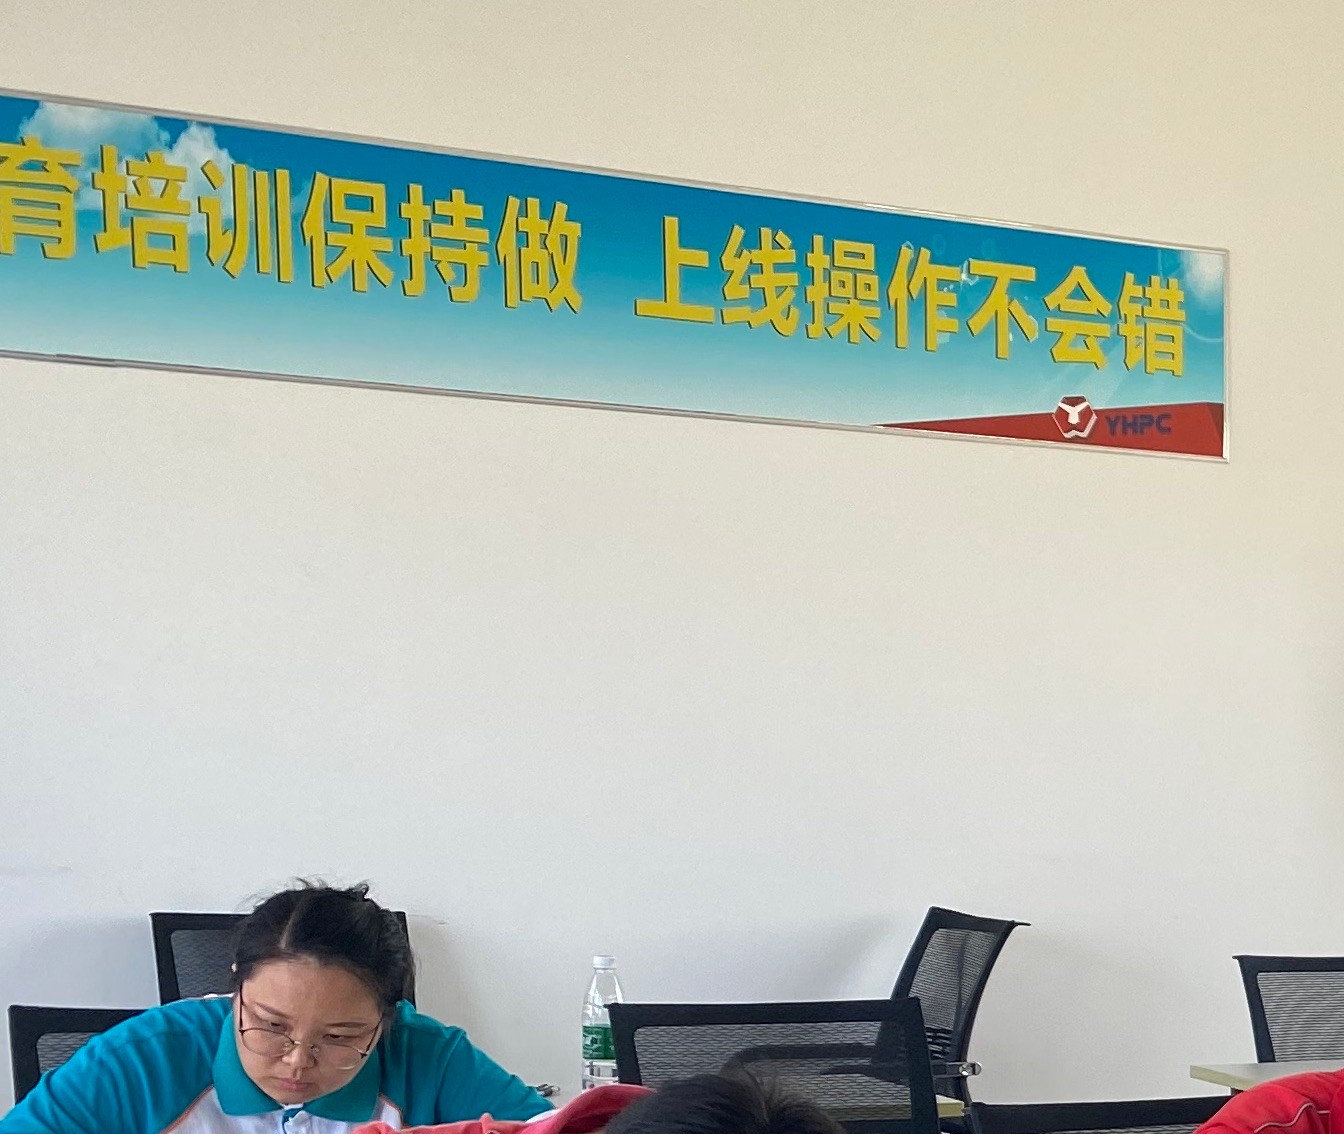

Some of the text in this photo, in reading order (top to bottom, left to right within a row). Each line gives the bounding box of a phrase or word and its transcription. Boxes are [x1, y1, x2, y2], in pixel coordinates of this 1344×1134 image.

[0, 136, 1186, 375] 育培训保持做 上线操作不会错
[1105, 412, 1172, 437] YHPC
